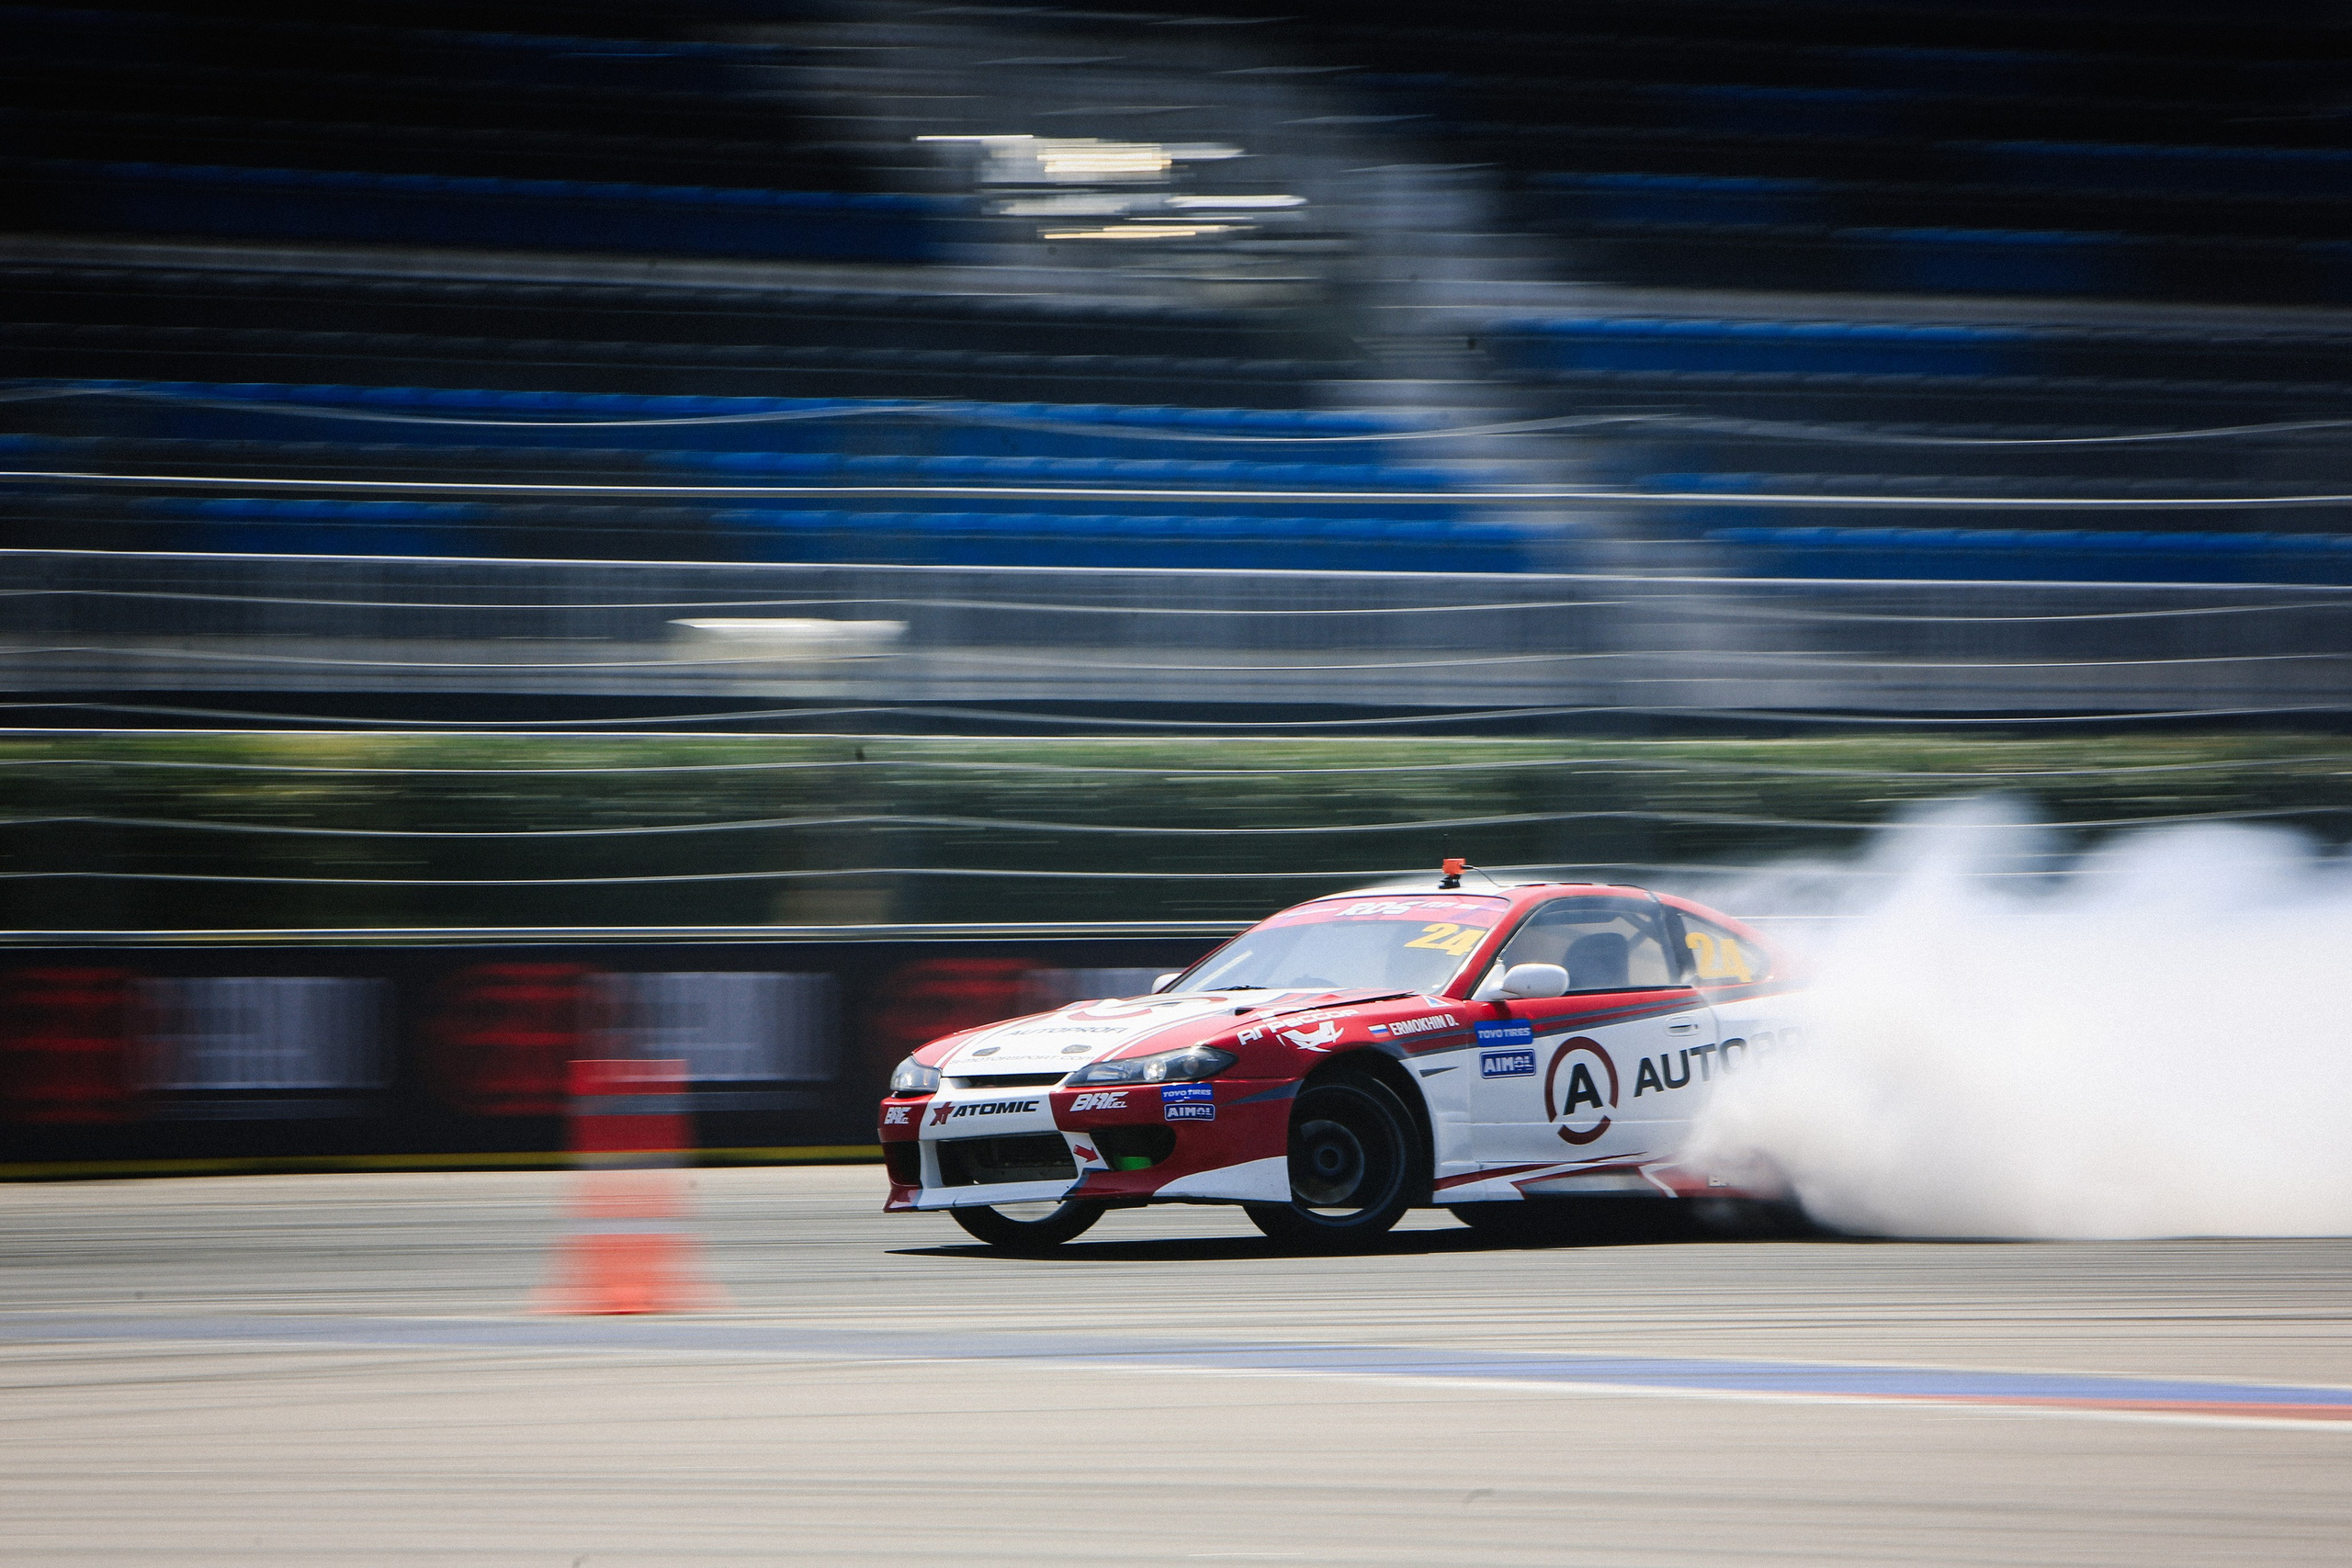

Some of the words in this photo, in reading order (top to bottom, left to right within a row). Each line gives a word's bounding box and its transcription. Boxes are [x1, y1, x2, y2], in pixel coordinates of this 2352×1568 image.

[1334, 901, 1427, 917] RDS
[1403, 923, 1487, 956] 24
[1685, 931, 1752, 983] 24
[1389, 1015, 1445, 1036] ERMOKHIN
[1445, 1013, 1460, 1027] D.
[1477, 1029, 1503, 1039] TOYO
[1503, 1027, 1532, 1037] TIRES
[1483, 1055, 1534, 1073] AIMOL
[1563, 1062, 1604, 1116] A
[953, 1100, 1040, 1118] ATOMIC
[1167, 1106, 1213, 1118] AIMOL
